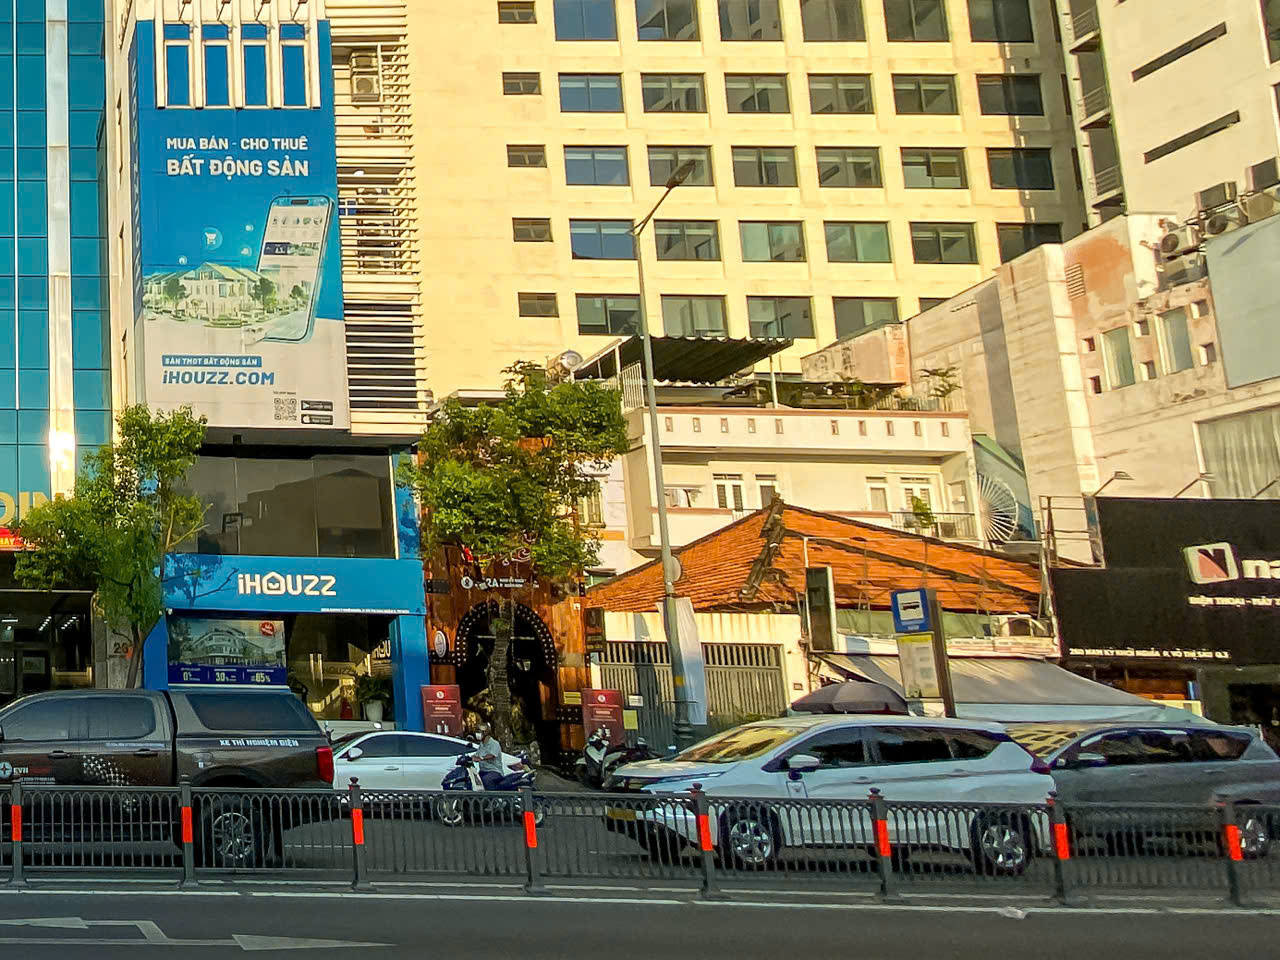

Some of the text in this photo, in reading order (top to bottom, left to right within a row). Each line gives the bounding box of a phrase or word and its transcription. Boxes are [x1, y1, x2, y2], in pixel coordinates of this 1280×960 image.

[166, 138, 196, 150] MUA
[200, 135, 228, 150] BÁN
[240, 138, 269, 150] CHO
[271, 136, 308, 150] THUÊ
[167, 154, 308, 180] BẤT ĐỘNG SẢN
[162, 370, 275, 385] iHOUZZ.COM
[237, 571, 337, 596] iHOUZZ
